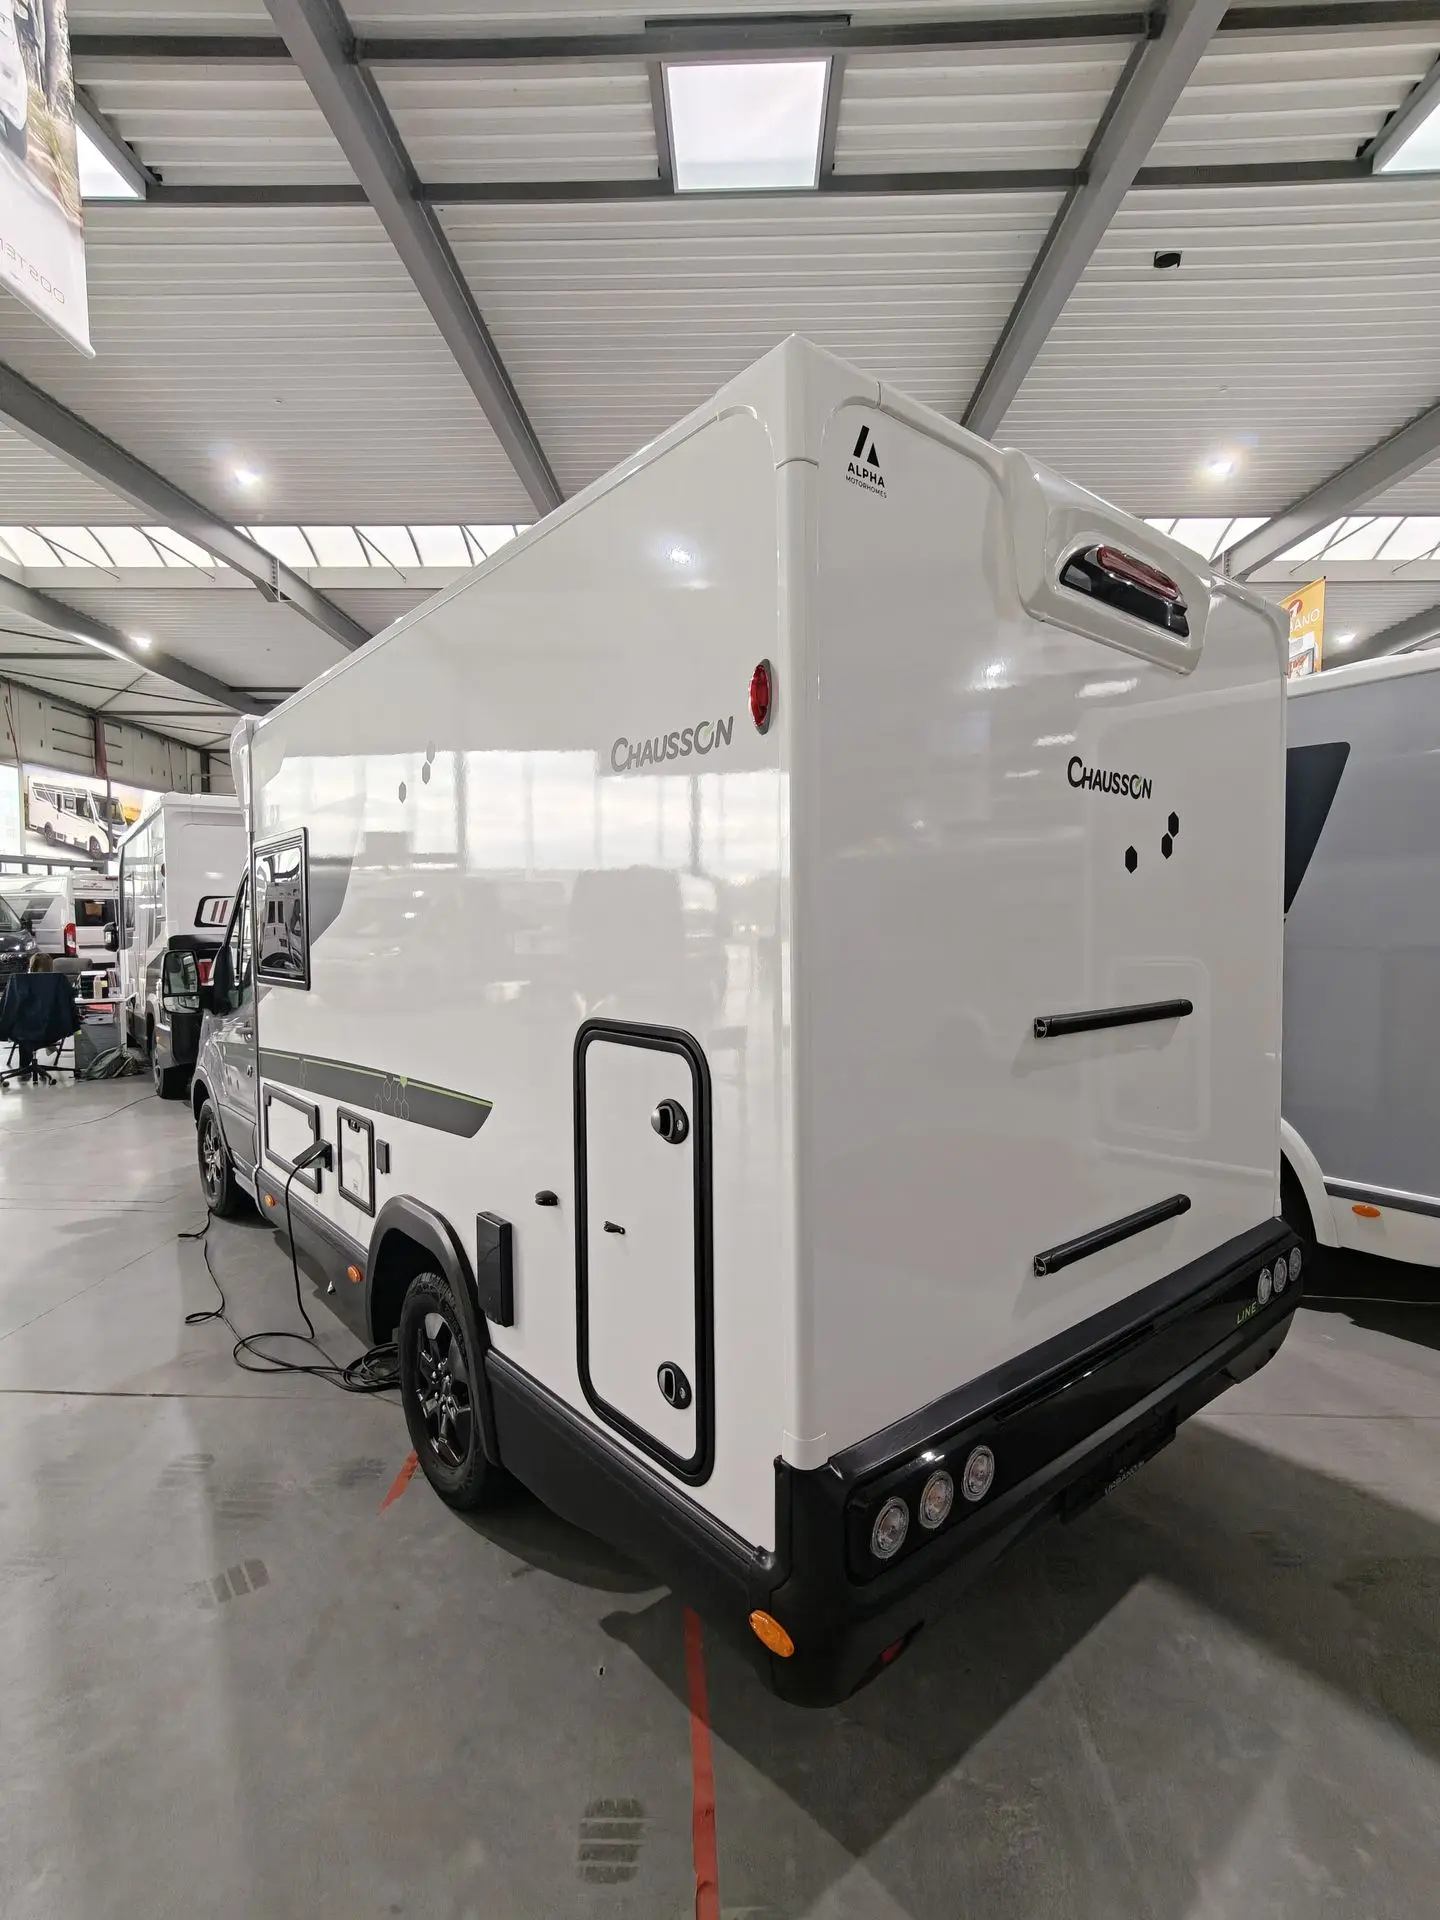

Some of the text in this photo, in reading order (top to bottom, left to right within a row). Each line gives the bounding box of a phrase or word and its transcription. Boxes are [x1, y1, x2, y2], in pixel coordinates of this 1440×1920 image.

[845, 474, 888, 499] MOTORHOMES
[847, 462, 885, 488] ALPHA
[610, 716, 734, 772] CHAUSSON
[1067, 756, 1152, 799] CHAUSSON
[1236, 1301, 1257, 1325] LINE
